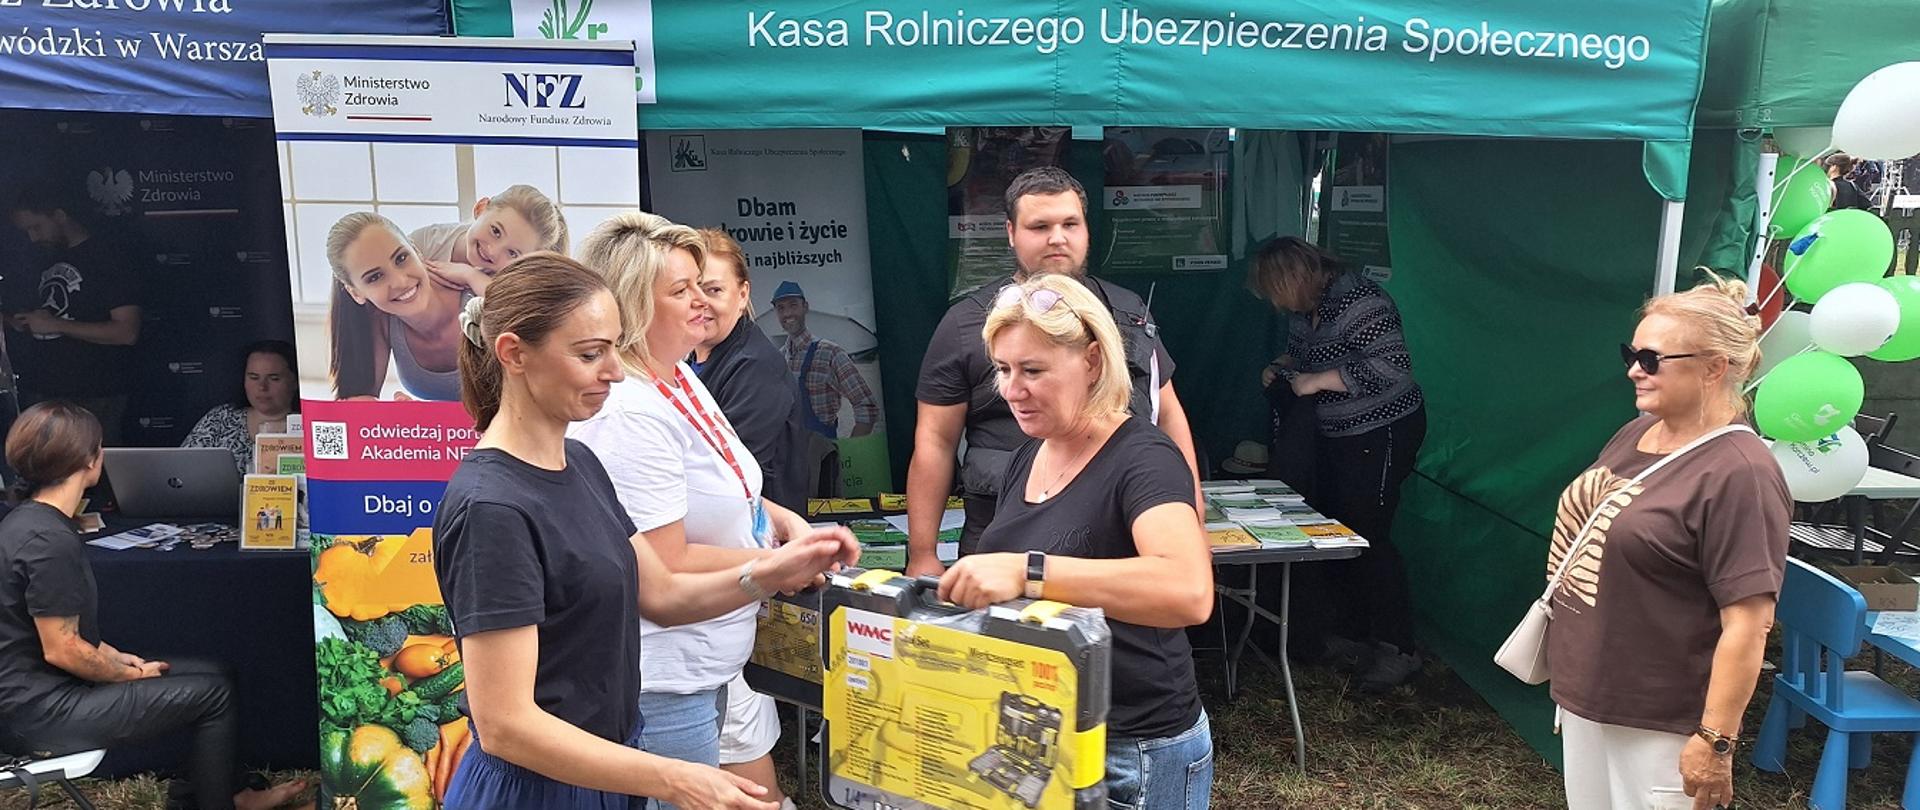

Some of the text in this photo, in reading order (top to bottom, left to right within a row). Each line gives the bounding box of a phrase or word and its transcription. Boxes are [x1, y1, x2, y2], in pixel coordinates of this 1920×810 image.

[114, 38, 141, 58] w
[150, 32, 265, 61] Warsza
[748, 8, 1650, 68] Kasa Rolniczego Ubezpieczenia Społecznego
[343, 75, 430, 91] Ministerstwo
[502, 73, 586, 109] NFZ
[344, 93, 399, 107] Zdrowia
[478, 113, 612, 126] Narodowy Fundusz Zdrowia
[139, 170, 234, 184] Ministerstwo
[141, 188, 201, 202] Zdrowia
[737, 197, 796, 217] Dbam
[721, 220, 848, 244] rowie i życie
[755, 249, 842, 269] najbliższych
[360, 424, 442, 442] odwiedzaj
[361, 445, 474, 460] Akademia NF
[364, 495, 432, 517] Dbaj o
[847, 620, 892, 642] WMC
